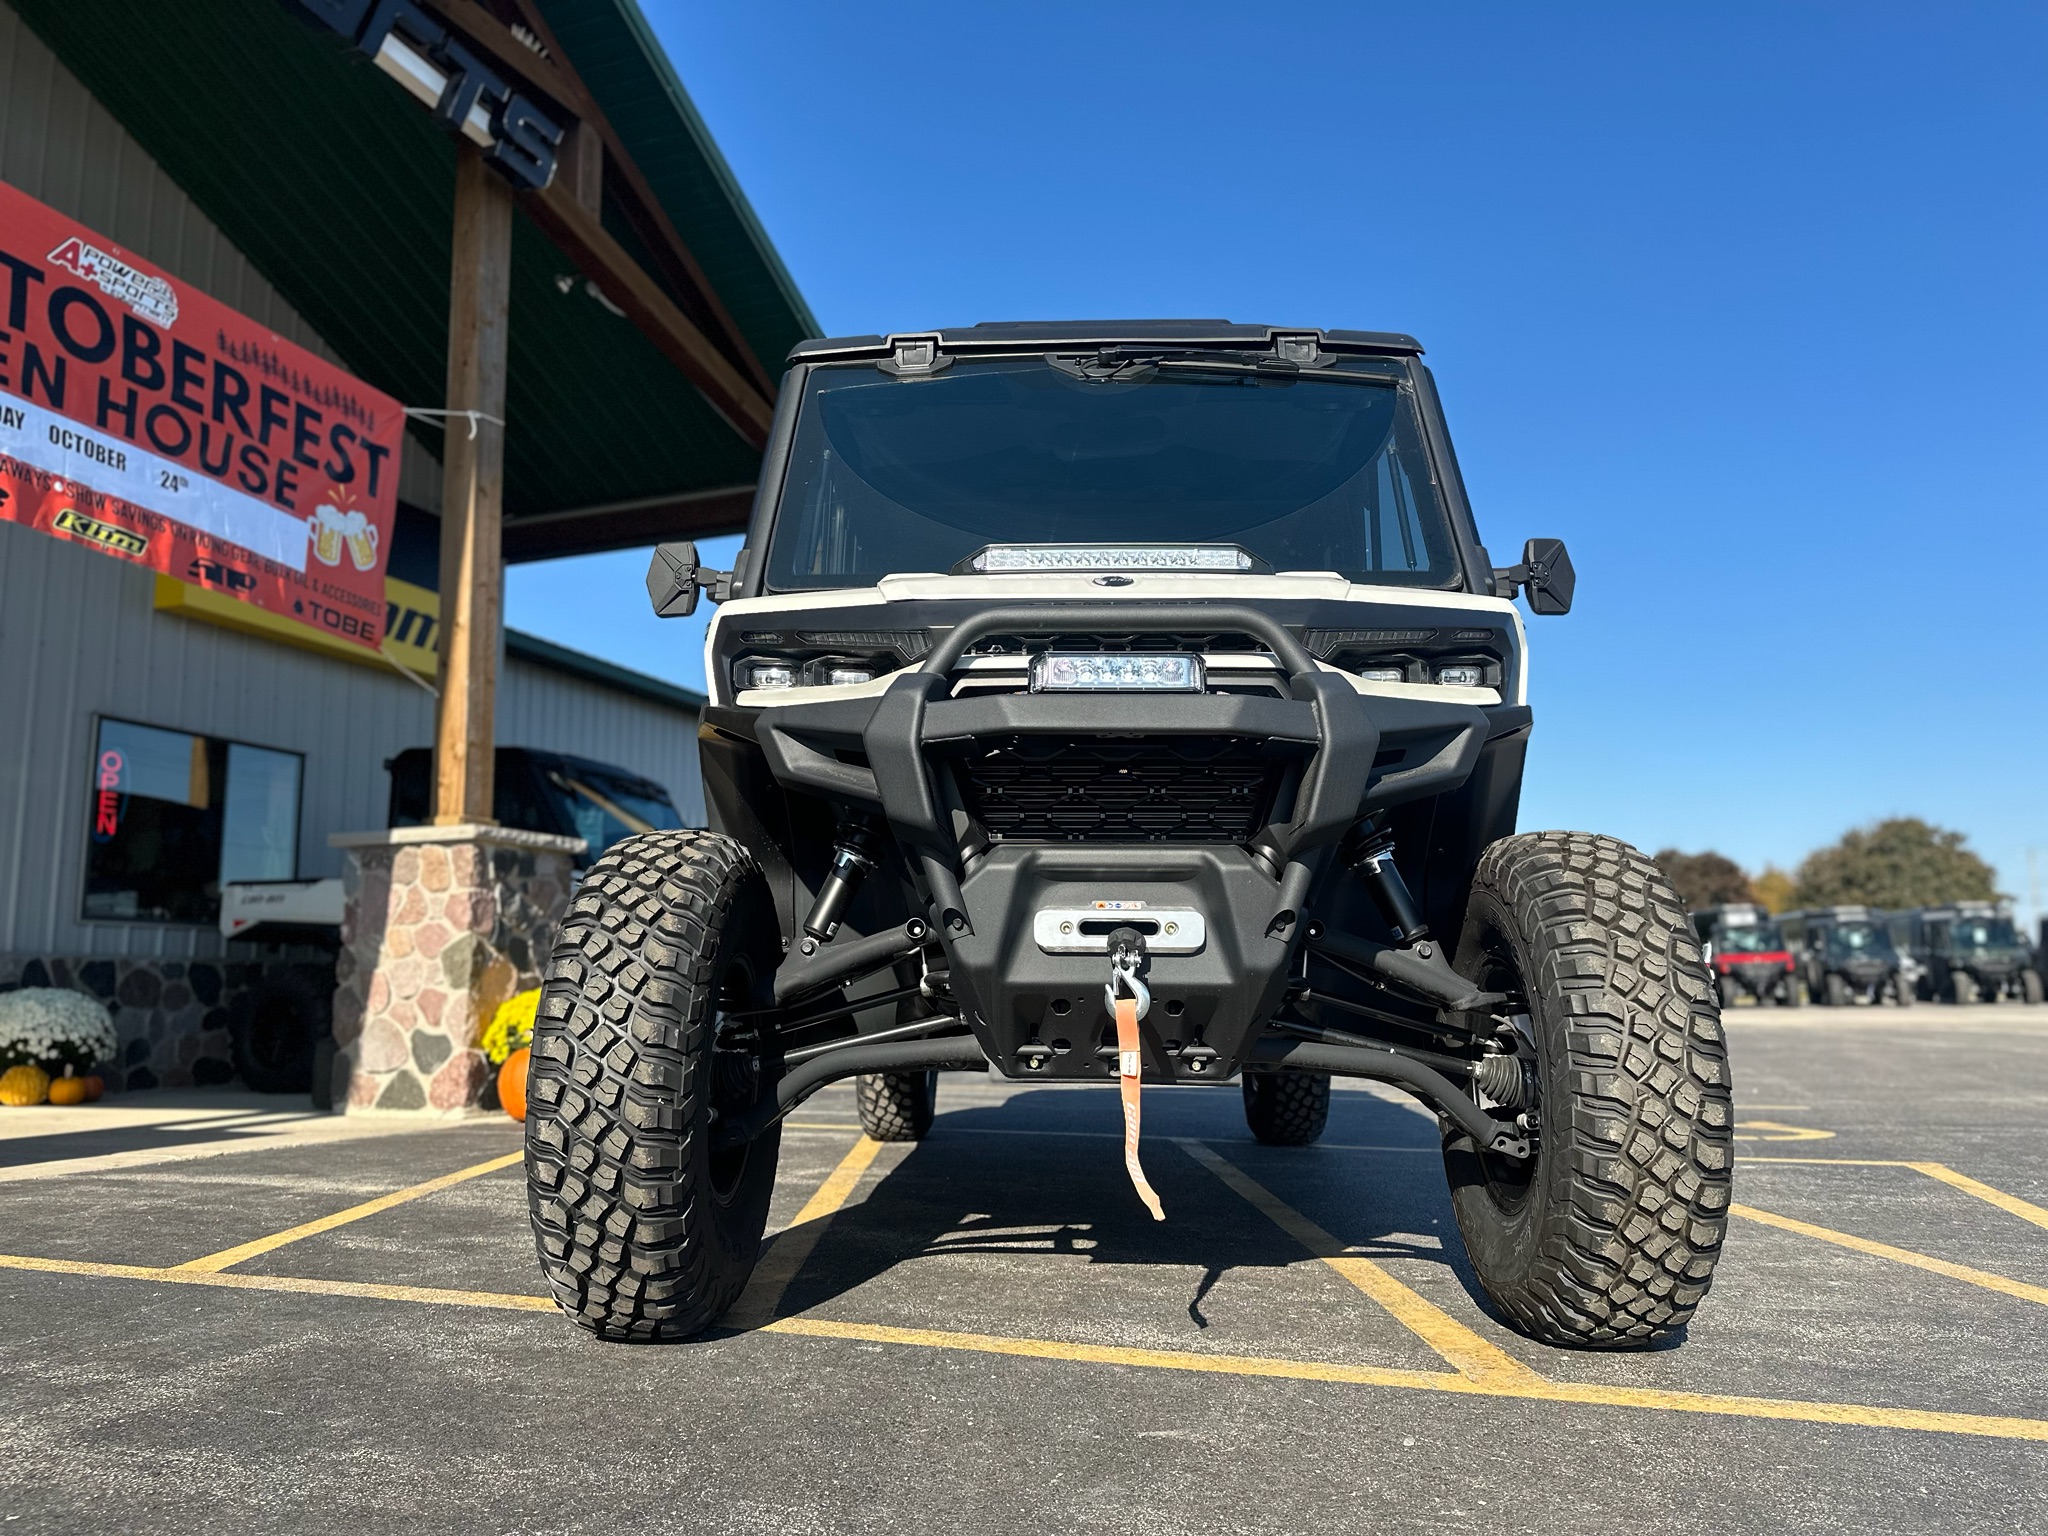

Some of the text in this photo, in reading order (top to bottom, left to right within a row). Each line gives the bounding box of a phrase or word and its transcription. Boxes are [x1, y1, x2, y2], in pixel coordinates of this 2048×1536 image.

[0, 250, 390, 498] TOBERFEST
[49, 424, 127, 472] OCTOBER
[160, 470, 189, 493] 24th
[96, 374, 300, 510] HOUSE
[65, 482, 106, 511] SHOW
[112, 500, 166, 533] SAVINGS
[322, 582, 381, 618] ACCESSORIES
[308, 600, 376, 642] TOBE
[97, 751, 123, 836] OPEN
[1125, 1101, 1146, 1184] can-am
